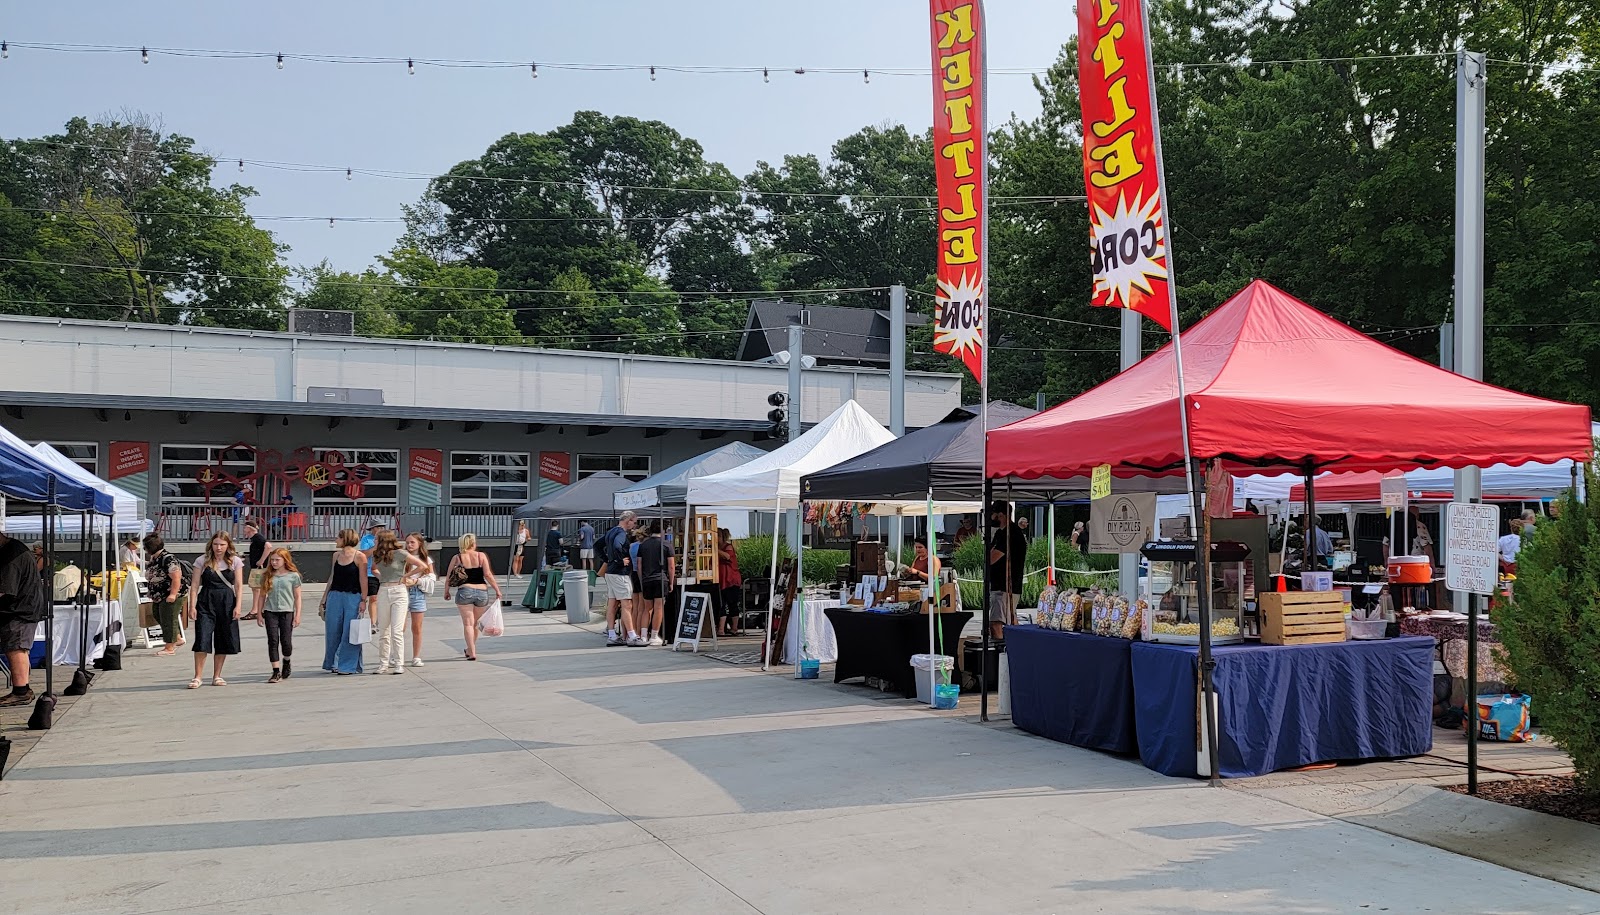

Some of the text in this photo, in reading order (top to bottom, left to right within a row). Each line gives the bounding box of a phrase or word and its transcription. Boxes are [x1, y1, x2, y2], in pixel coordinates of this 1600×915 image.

[119, 447, 140, 456] CREATE
[120, 453, 143, 462] INSPIRE
[116, 459, 145, 470] ENERGIZE
[415, 455, 439, 467] CONNECT
[543, 456, 560, 465] FAMILY
[411, 466, 438, 479] CELEBRATE
[540, 466, 563, 477] WELCOME
[541, 461, 569, 474] COMMUNITY
[1453, 506, 1491, 518] UNAUTHORIZED
[1107, 521, 1141, 532] DIY PICKLES
[1451, 516, 1495, 531] VEHICLES WILL BE
[1453, 528, 1492, 541] TOWED AWAY AT
[1450, 538, 1495, 553] OWNER'S EXPENSE
[1453, 554, 1491, 568] RELIABLE ROAD
[1461, 566, 1482, 579] SERVICE
